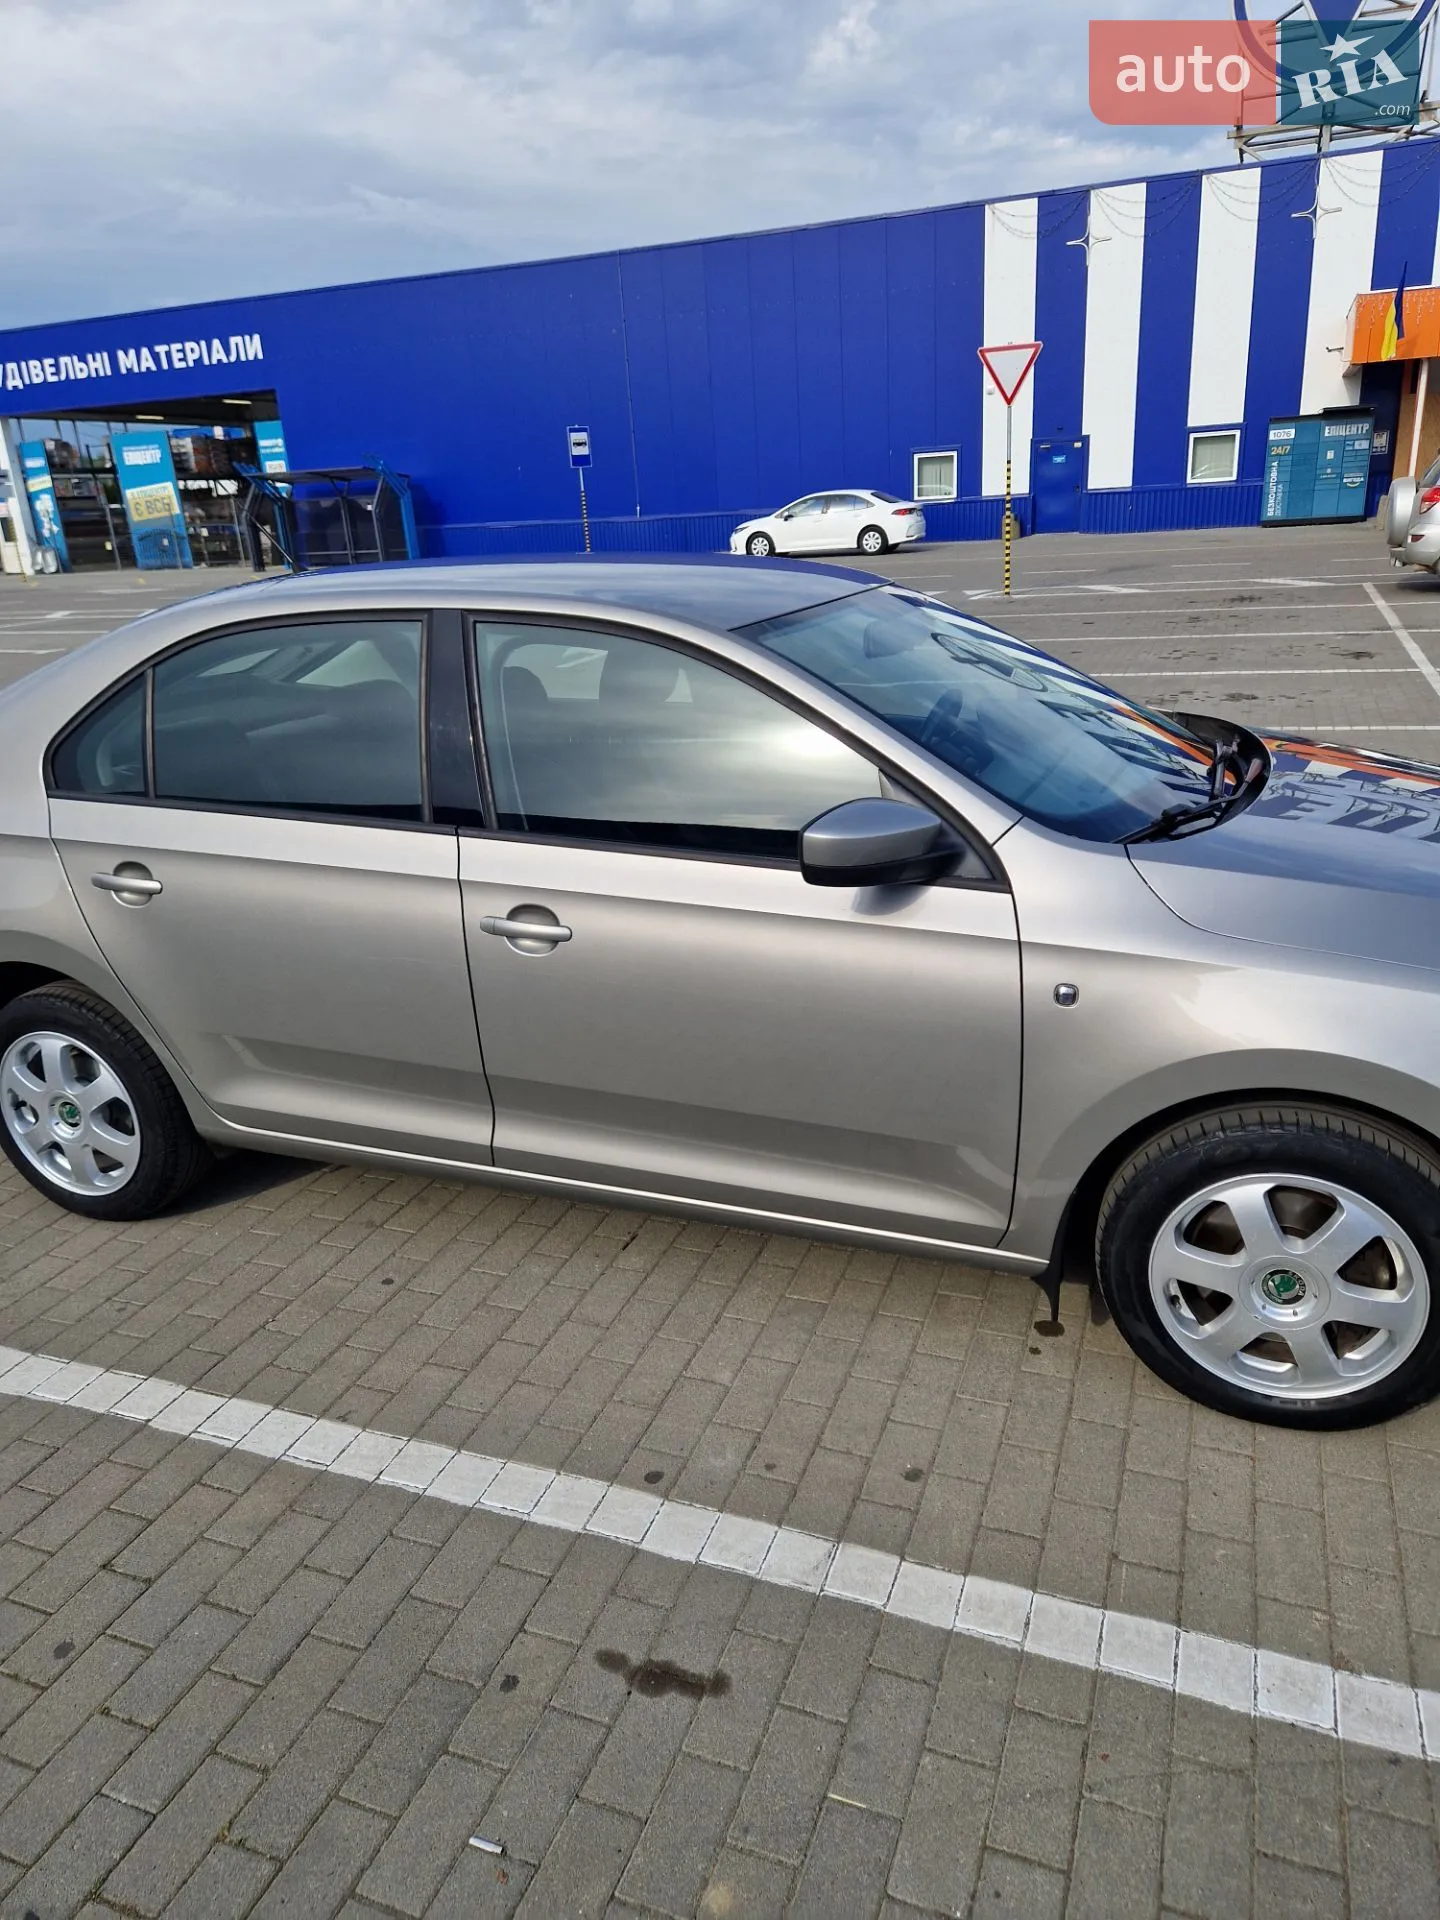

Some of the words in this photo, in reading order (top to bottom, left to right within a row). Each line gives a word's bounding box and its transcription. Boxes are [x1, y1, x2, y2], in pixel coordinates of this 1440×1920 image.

[0, 351, 112, 391] ДІВЕЛЬНІ
[116, 333, 264, 375] МАТЕРІАЛИ
[1272, 430, 1292, 439] 1076
[1325, 423, 1370, 437] ЕПІЦЕНТР
[1267, 461, 1279, 516] БЕЗКОШТОВНА
